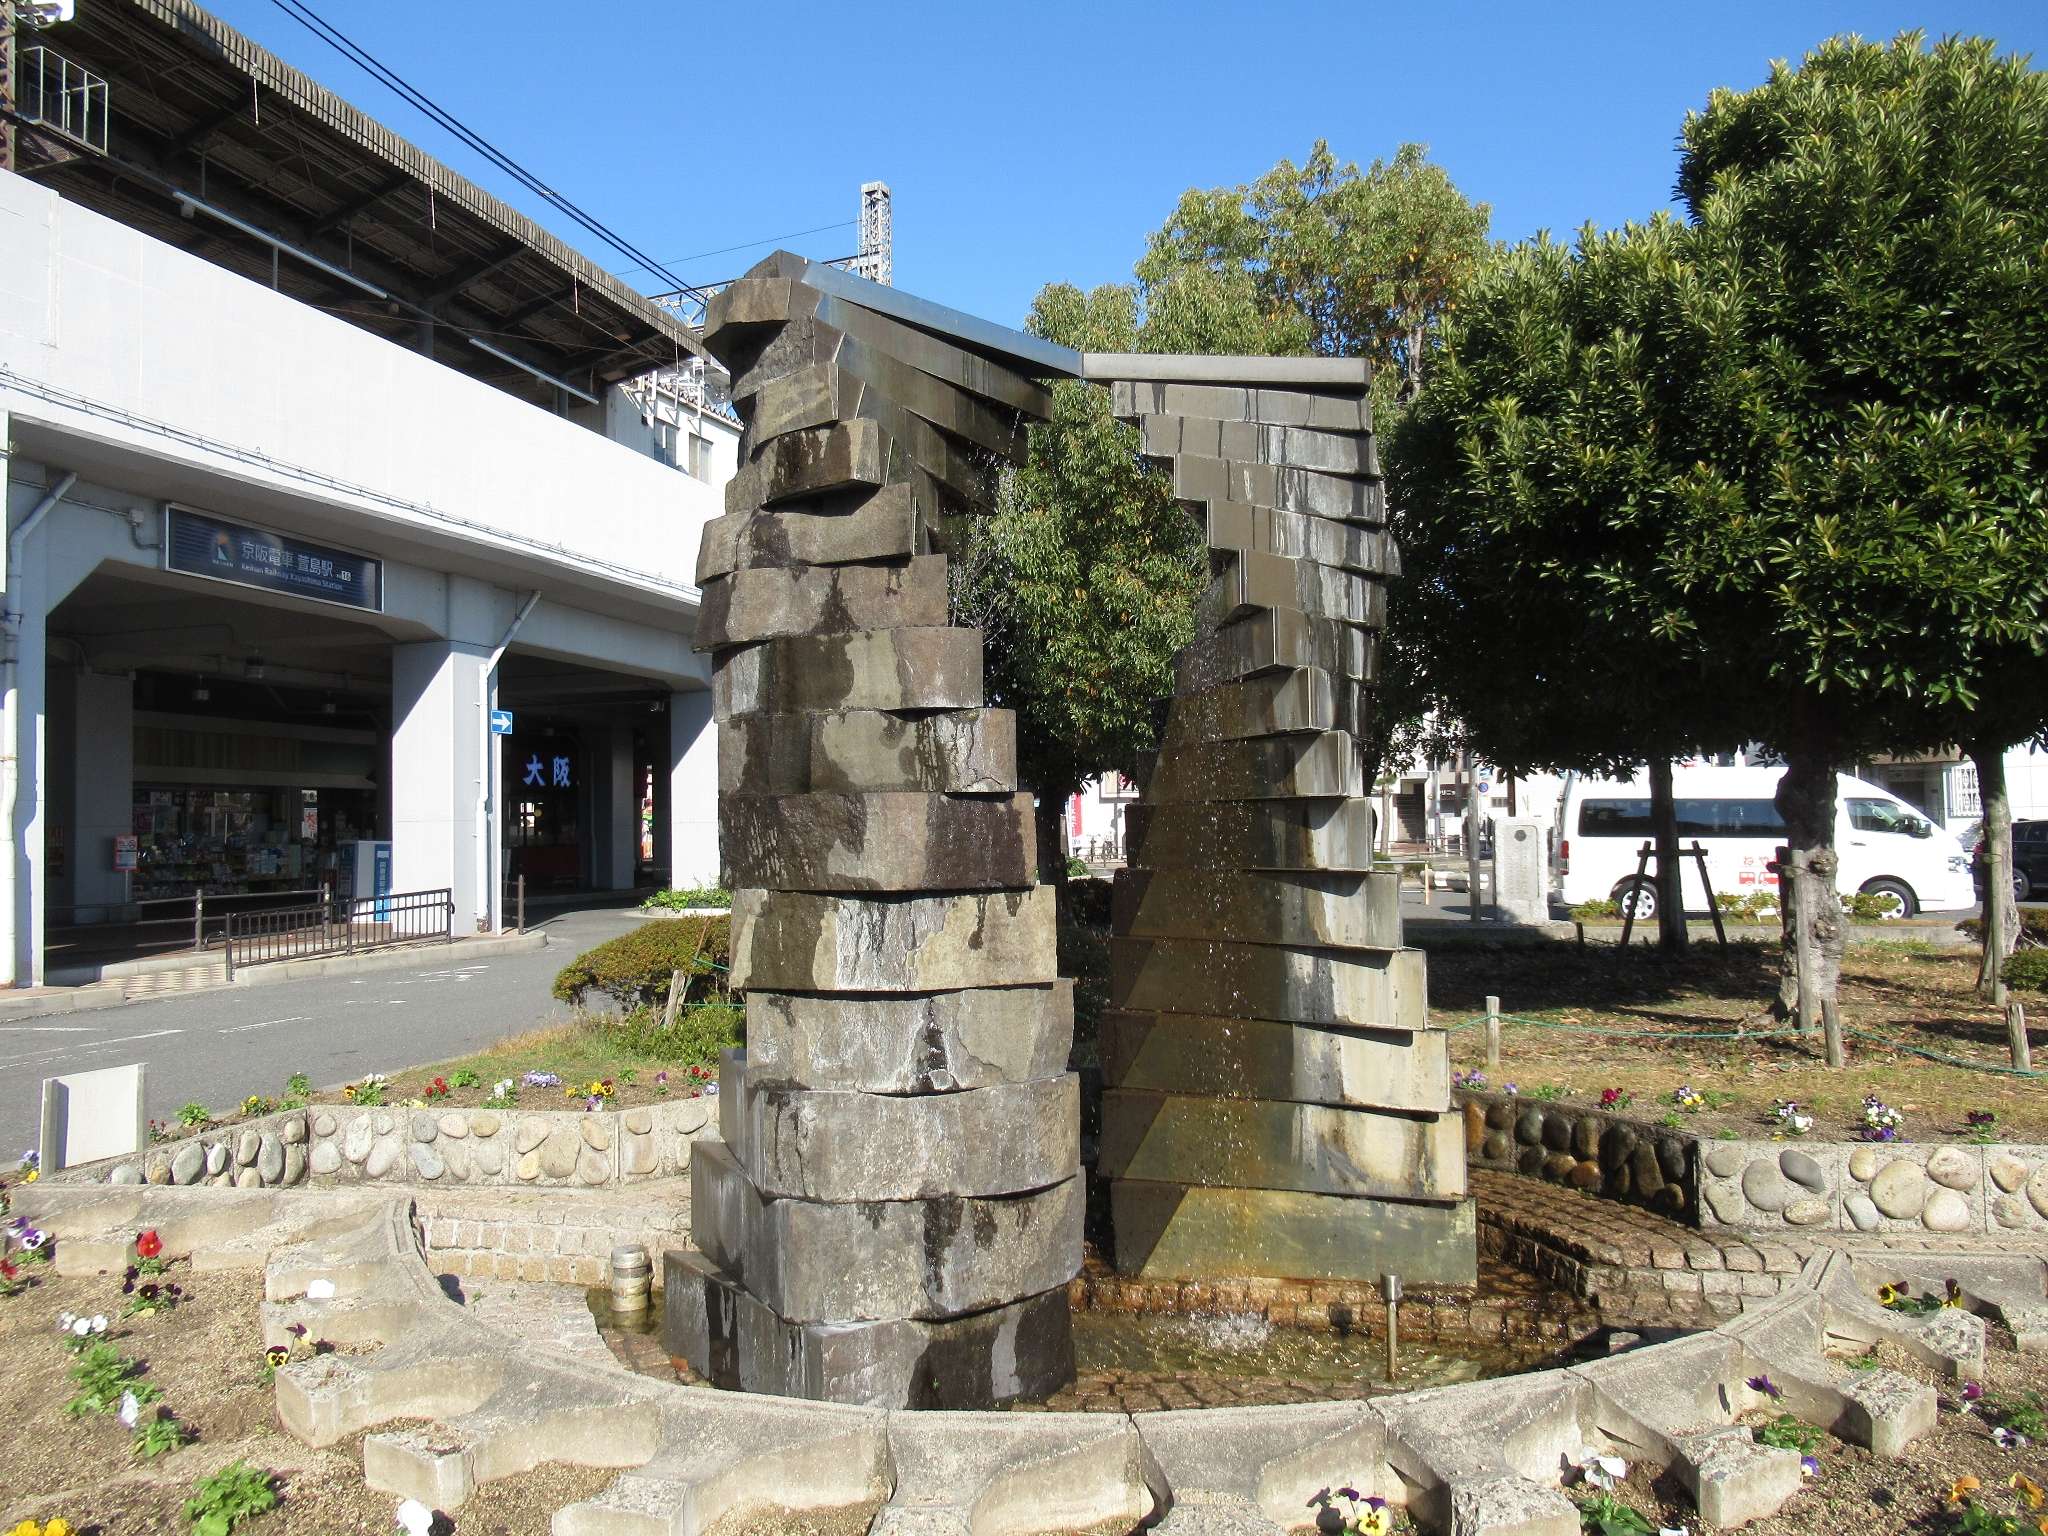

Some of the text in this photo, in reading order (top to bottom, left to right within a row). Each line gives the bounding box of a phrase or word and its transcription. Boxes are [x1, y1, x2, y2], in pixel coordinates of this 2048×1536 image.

[242, 542, 294, 567] 京阪電車
[297, 554, 333, 577] 萱島駅
[522, 754, 571, 788] 大阪
